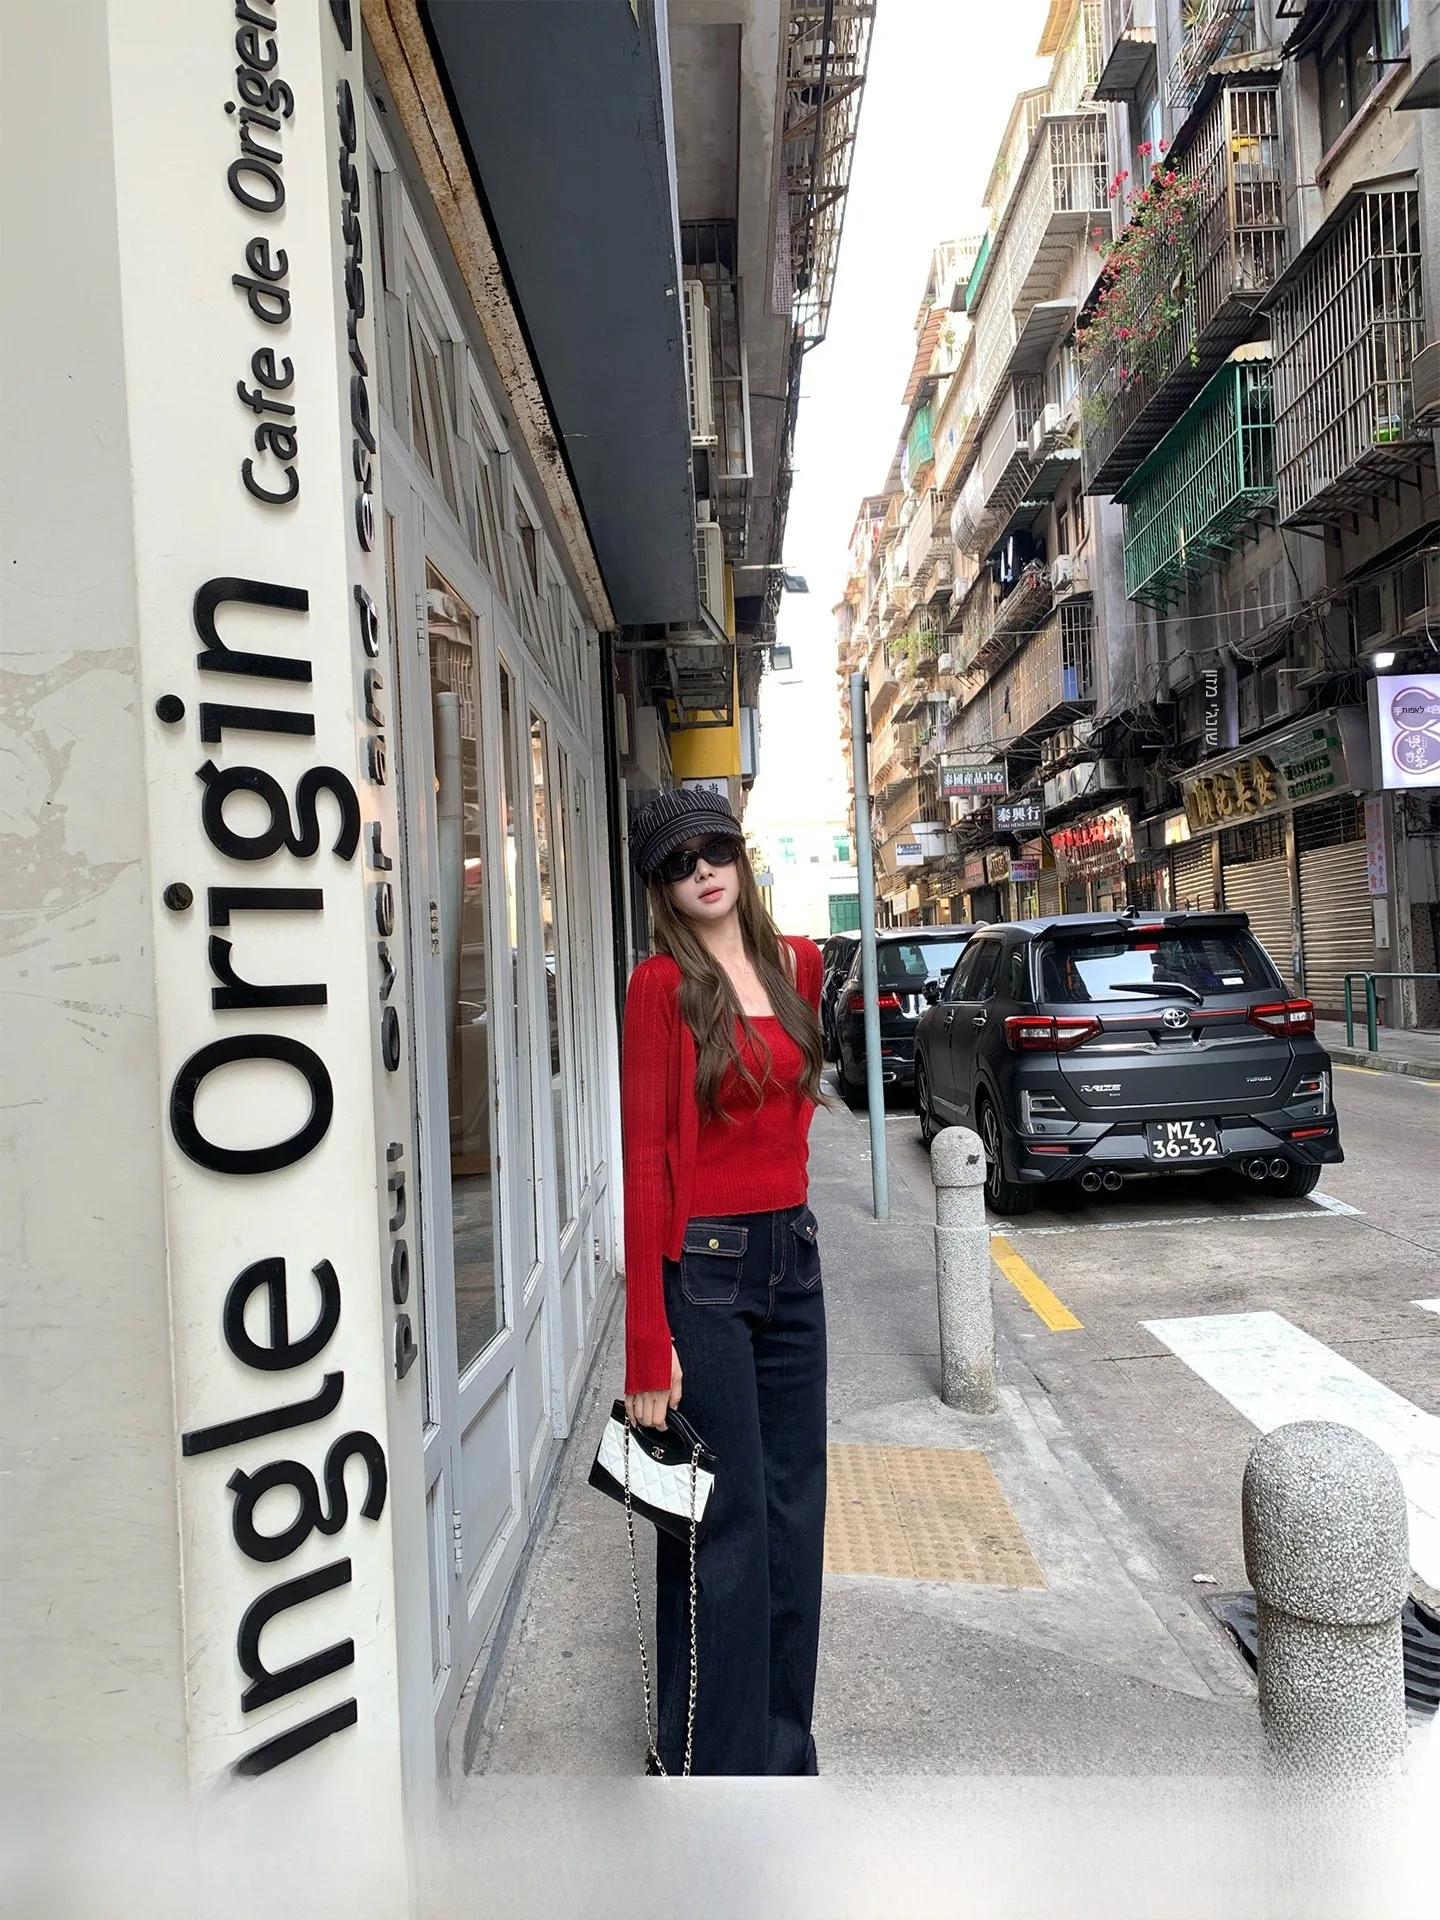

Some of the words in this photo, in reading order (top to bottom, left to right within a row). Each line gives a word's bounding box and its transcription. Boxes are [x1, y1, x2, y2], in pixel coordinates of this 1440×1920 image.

[224, 0, 294, 213] Origen
[232, 236, 291, 325] de
[335, 77, 377, 553] espresso
[237, 346, 301, 505] Cafe
[354, 583, 388, 786] and
[155, 576, 361, 1175] Origin
[997, 805, 1041, 822] 泰興行
[371, 820, 401, 1072] over
[1080, 1084, 1122, 1092] RAIZE
[1153, 1137, 1218, 1159] 36-32
[1166, 1120, 1197, 1139] MZ
[386, 1141, 419, 1381] pour
